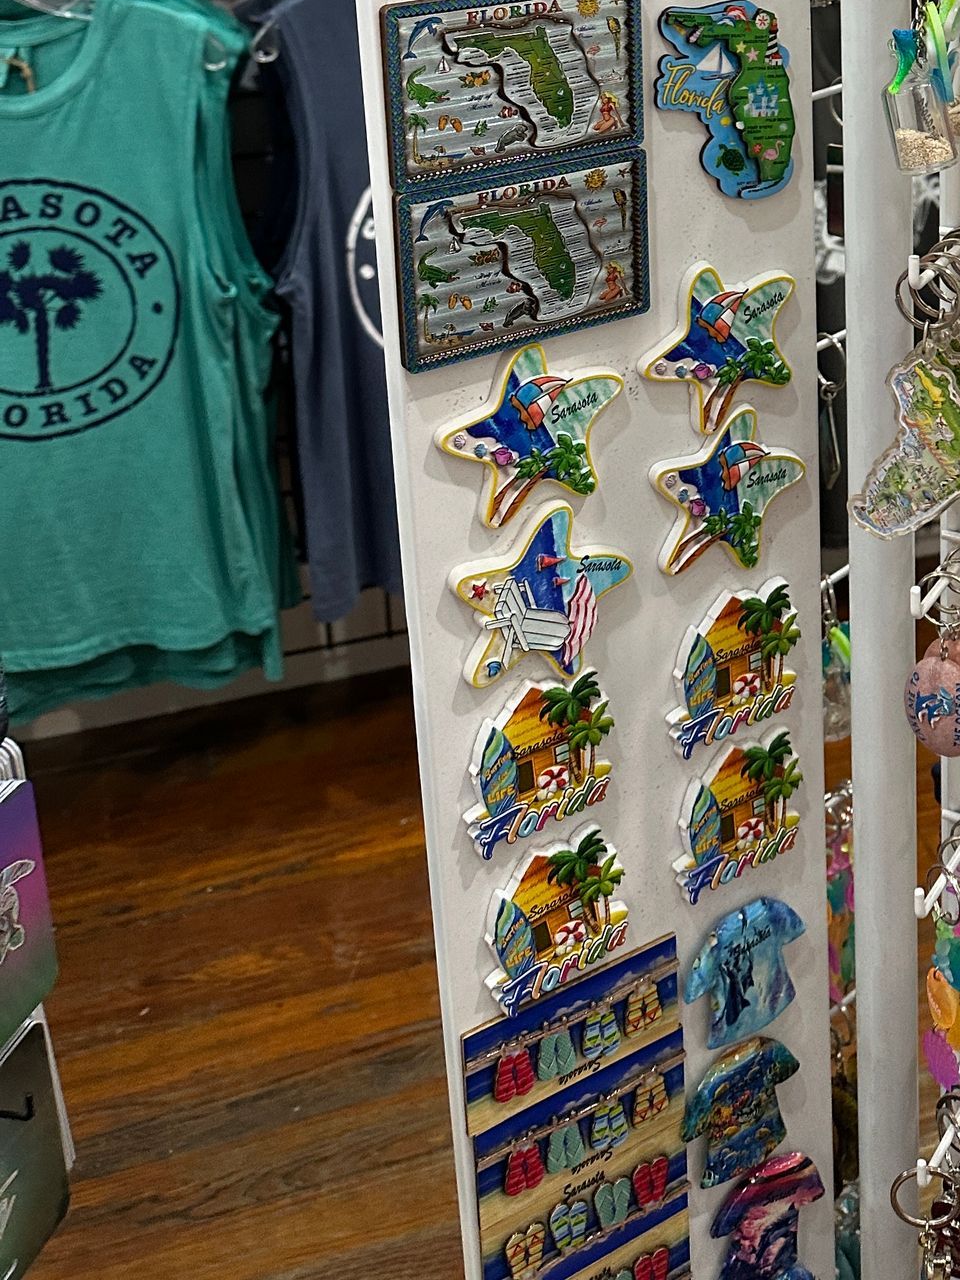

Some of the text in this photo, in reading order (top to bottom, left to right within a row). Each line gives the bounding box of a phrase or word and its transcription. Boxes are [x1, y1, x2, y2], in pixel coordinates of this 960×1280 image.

[466, 0, 563, 25] FLORIDA
[661, 62, 727, 118] Florida
[477, 176, 572, 205] FLORIDA
[0, 194, 159, 279] ASOTA
[743, 290, 785, 324] Sarasota
[3, 353, 157, 428] ORIDA
[551, 391, 599, 424] Sarasota
[746, 468, 787, 489] Sarasota
[576, 554, 622, 574] Sarasota
[910, 671, 920, 686] TO
[681, 684, 796, 760] Florida
[512, 731, 565, 760] Sarasota
[487, 783, 516, 804] LIFE
[480, 775, 611, 861] Florida
[688, 826, 798, 906] Florida
[502, 922, 628, 1018] Florida
[506, 945, 532, 969] LIFE
[557, 1058, 601, 1085] Sarasota
[571, 1148, 612, 1174] Sarasota
[563, 1171, 605, 1202] Sarasota
